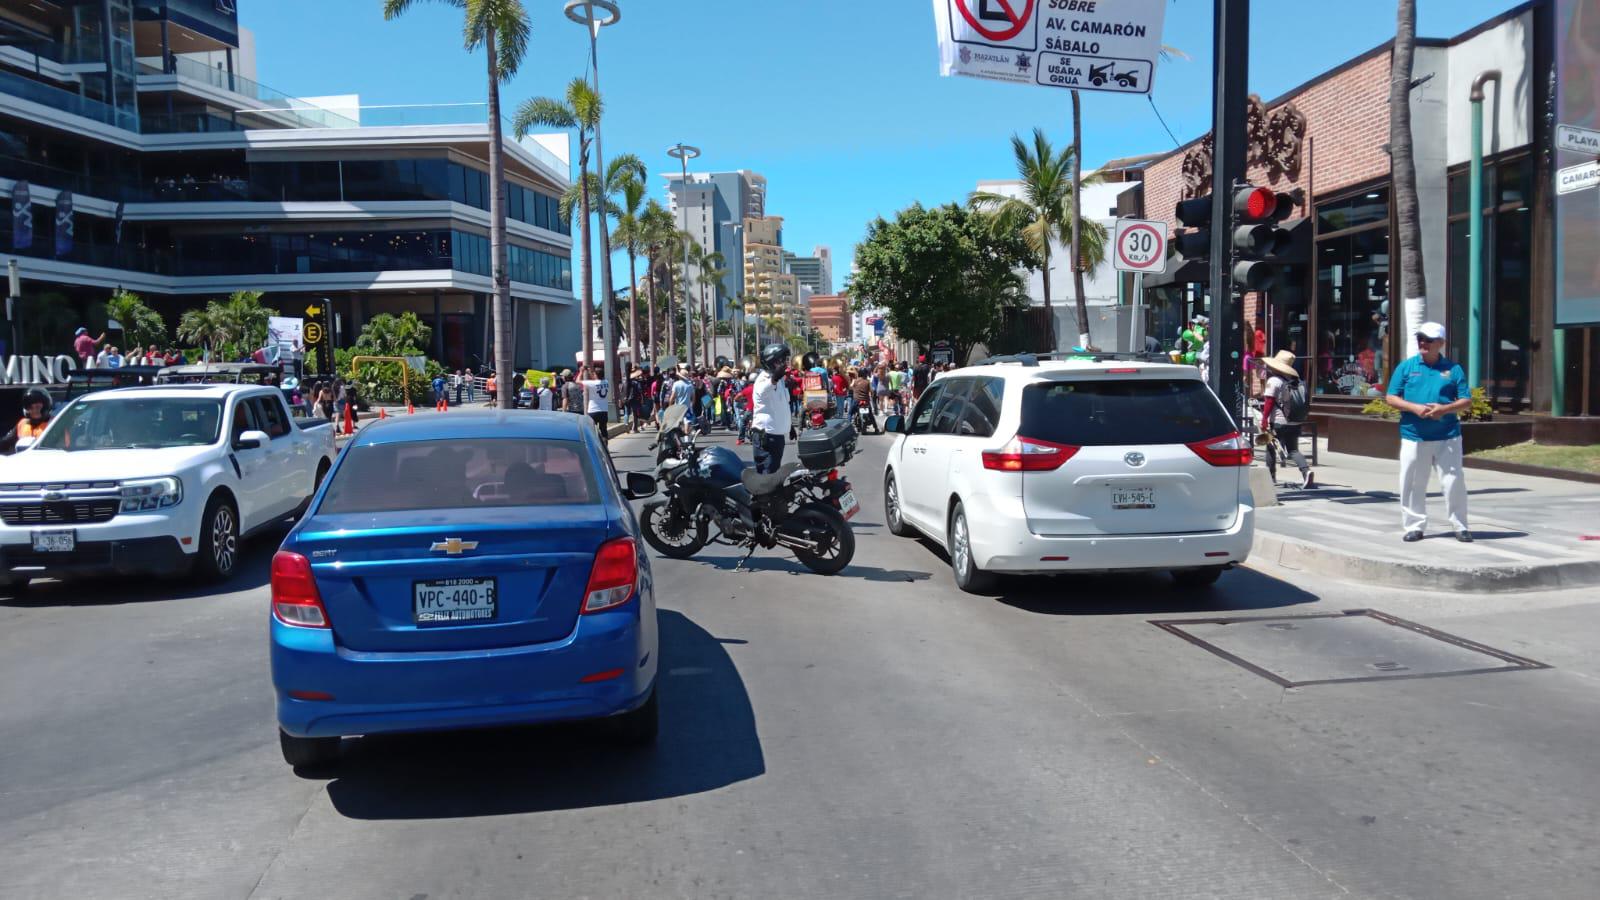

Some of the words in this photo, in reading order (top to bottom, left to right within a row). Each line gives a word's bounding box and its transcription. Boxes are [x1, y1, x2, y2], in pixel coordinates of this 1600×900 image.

[1048, 0, 1096, 13] SOBRE
[1046, 17, 1066, 31] AV.
[1071, 21, 1146, 38] CAMARÓN
[1045, 36, 1100, 54] SÁBALO
[1060, 57, 1071, 66] SE
[1048, 65, 1082, 76] USARA
[1049, 74, 1079, 85] GRUA
[1568, 134, 1599, 147] PLAYA
[1129, 232, 1152, 252] 30
[307, 326, 318, 339] E
[419, 588, 493, 608] VPC-440-B
